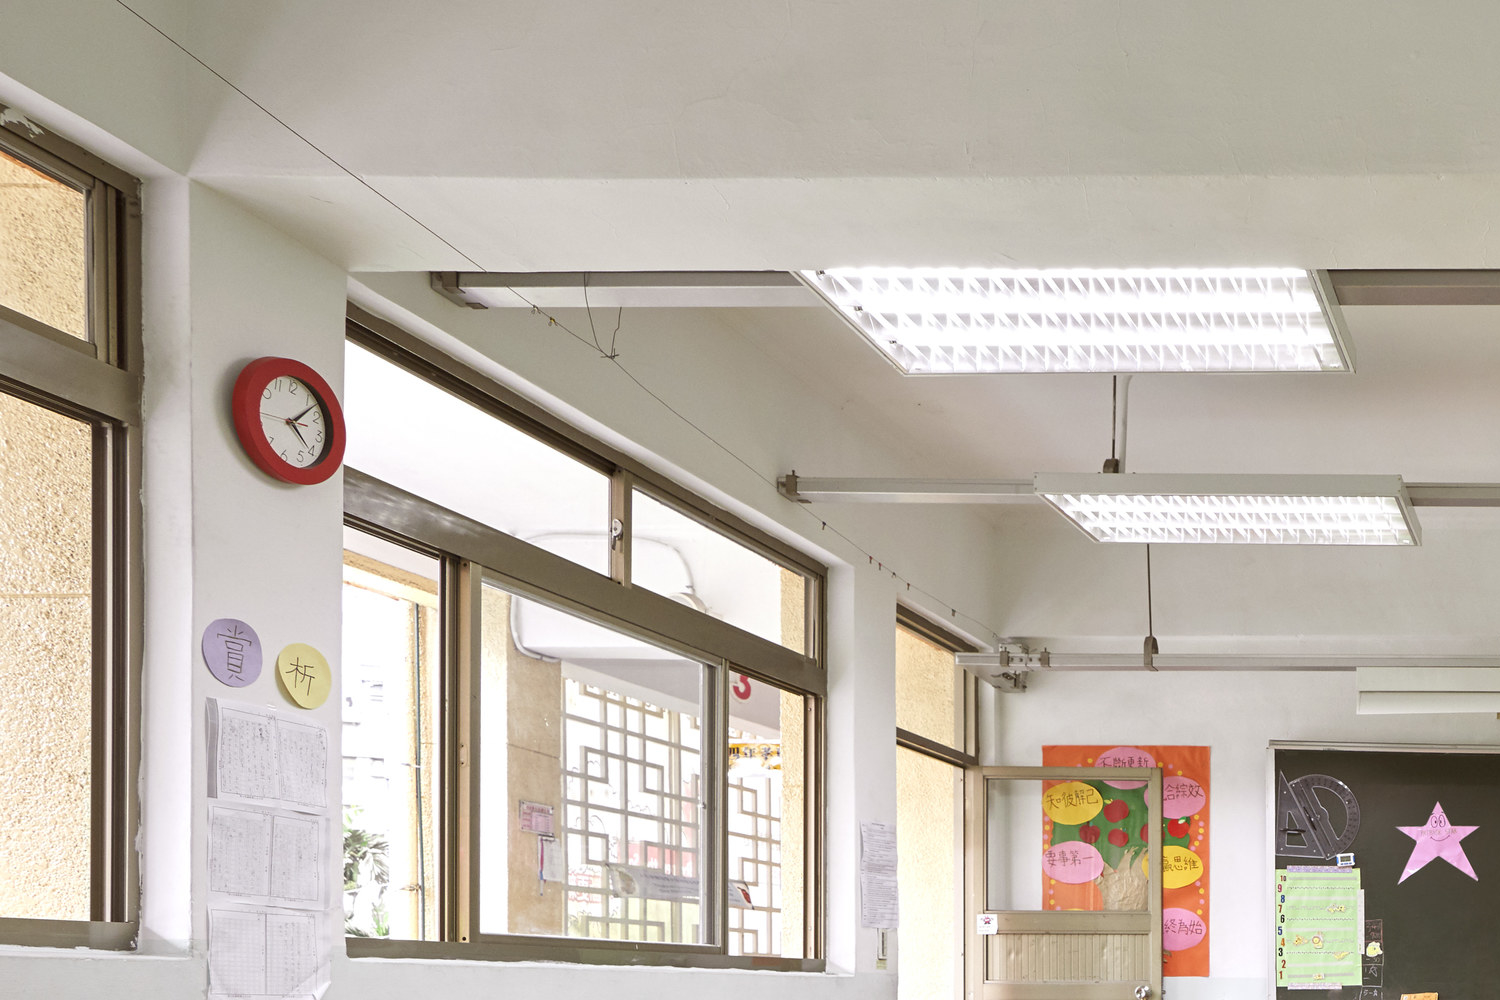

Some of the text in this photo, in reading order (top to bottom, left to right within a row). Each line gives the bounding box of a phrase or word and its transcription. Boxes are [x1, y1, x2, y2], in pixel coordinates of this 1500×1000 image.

[274, 378, 282, 393] 11
[288, 379, 299, 396] 12
[312, 411, 320, 424] 2
[315, 430, 323, 443] 3
[296, 450, 305, 463] 5
[307, 445, 316, 457] 4
[285, 657, 316, 696] 析
[1163, 783, 1204, 802] 合綜效
[1046, 788, 1099, 811] 知彼解己
[1045, 850, 1094, 867] 要事第一
[1277, 884, 1283, 893] 9
[1280, 894, 1286, 903] 8
[1278, 904, 1283, 913] 7
[1280, 914, 1286, 923] 6
[1277, 926, 1283, 935] 5
[1280, 938, 1286, 947] 4
[1278, 947, 1284, 956] 3
[1281, 960, 1287, 968] 2
[1279, 971, 1284, 979] 1
